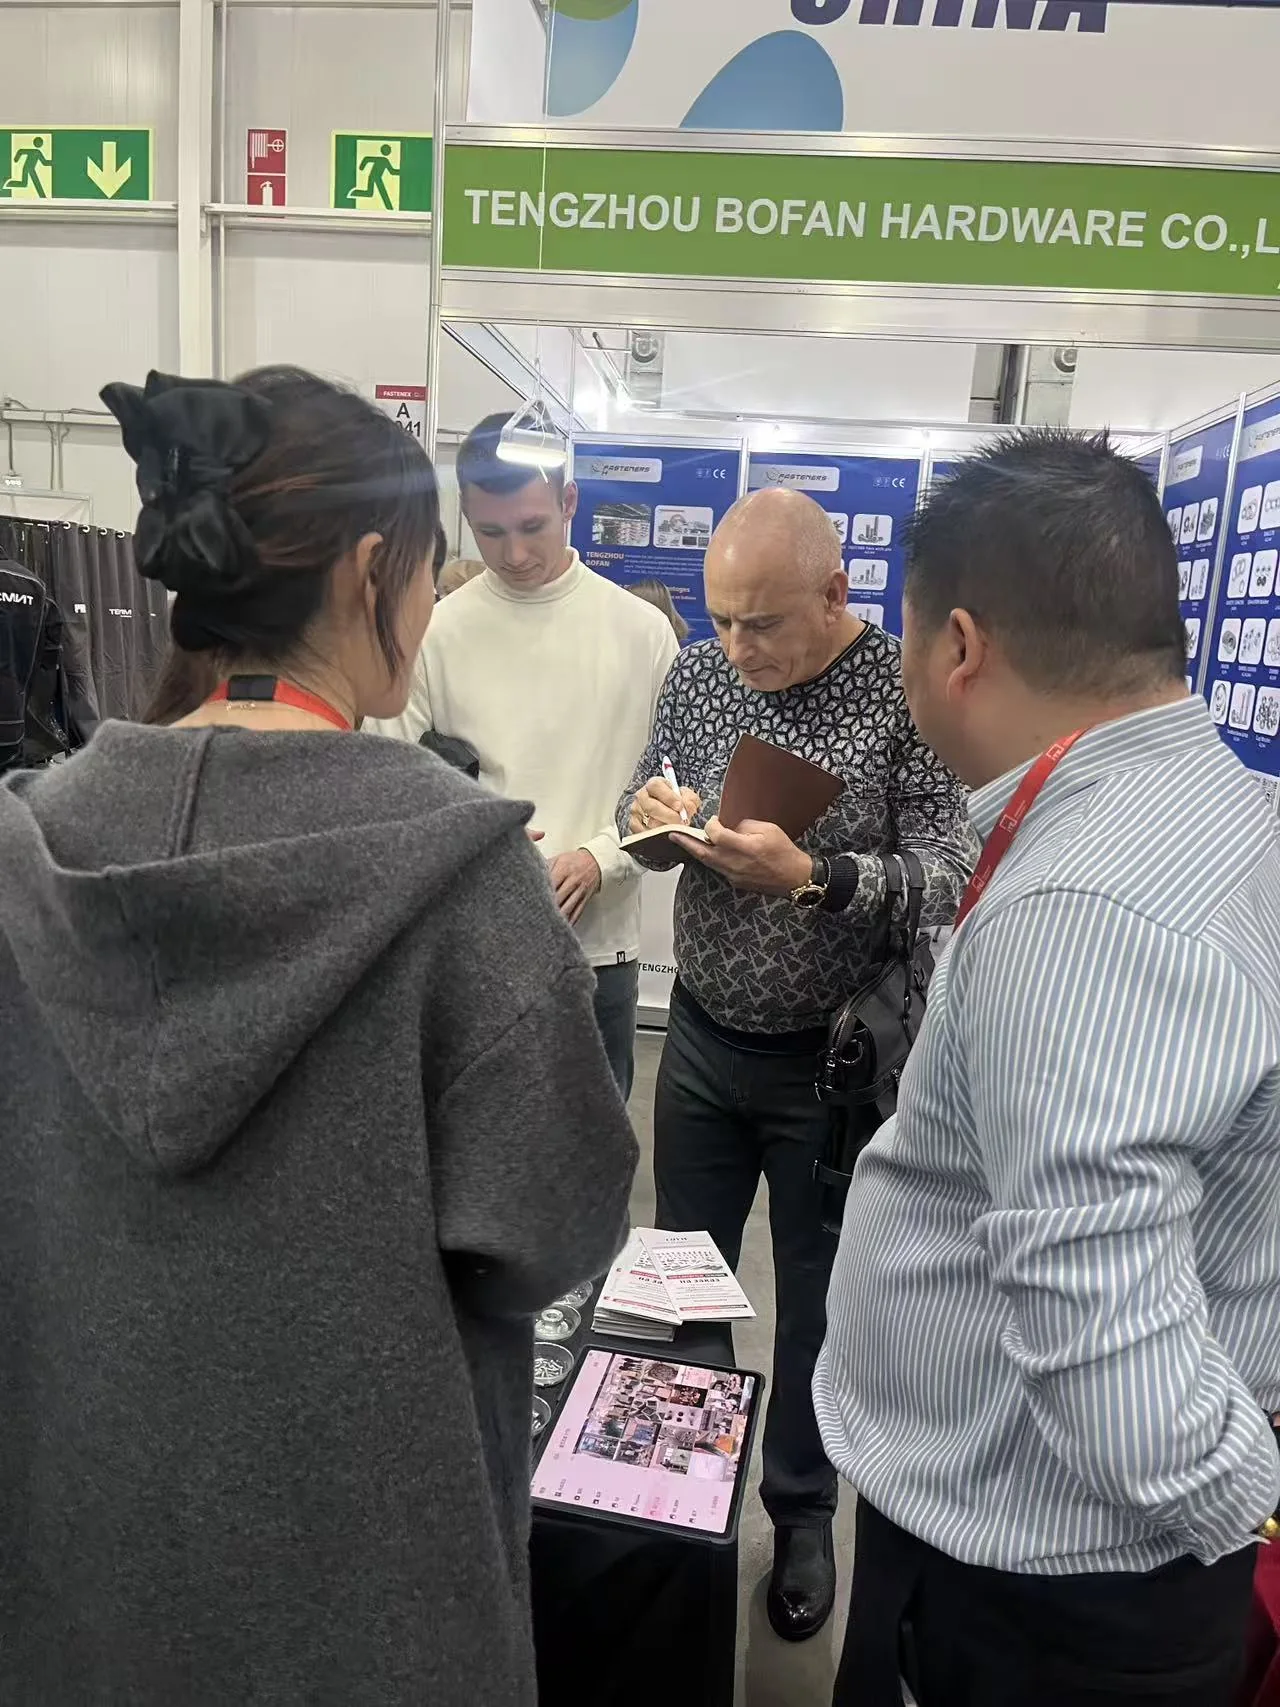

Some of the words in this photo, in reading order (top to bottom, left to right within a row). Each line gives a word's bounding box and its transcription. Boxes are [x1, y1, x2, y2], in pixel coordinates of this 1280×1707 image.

[464, 189, 700, 232] TENGZHOU
[715, 197, 866, 238] BOFAN
[880, 203, 1147, 247] HARDWARE
[1161, 213, 1280, 259] CO.,L
[396, 402, 410, 418] A
[586, 551, 624, 560] TENGZHOU
[586, 559, 610, 567] BOFAN
